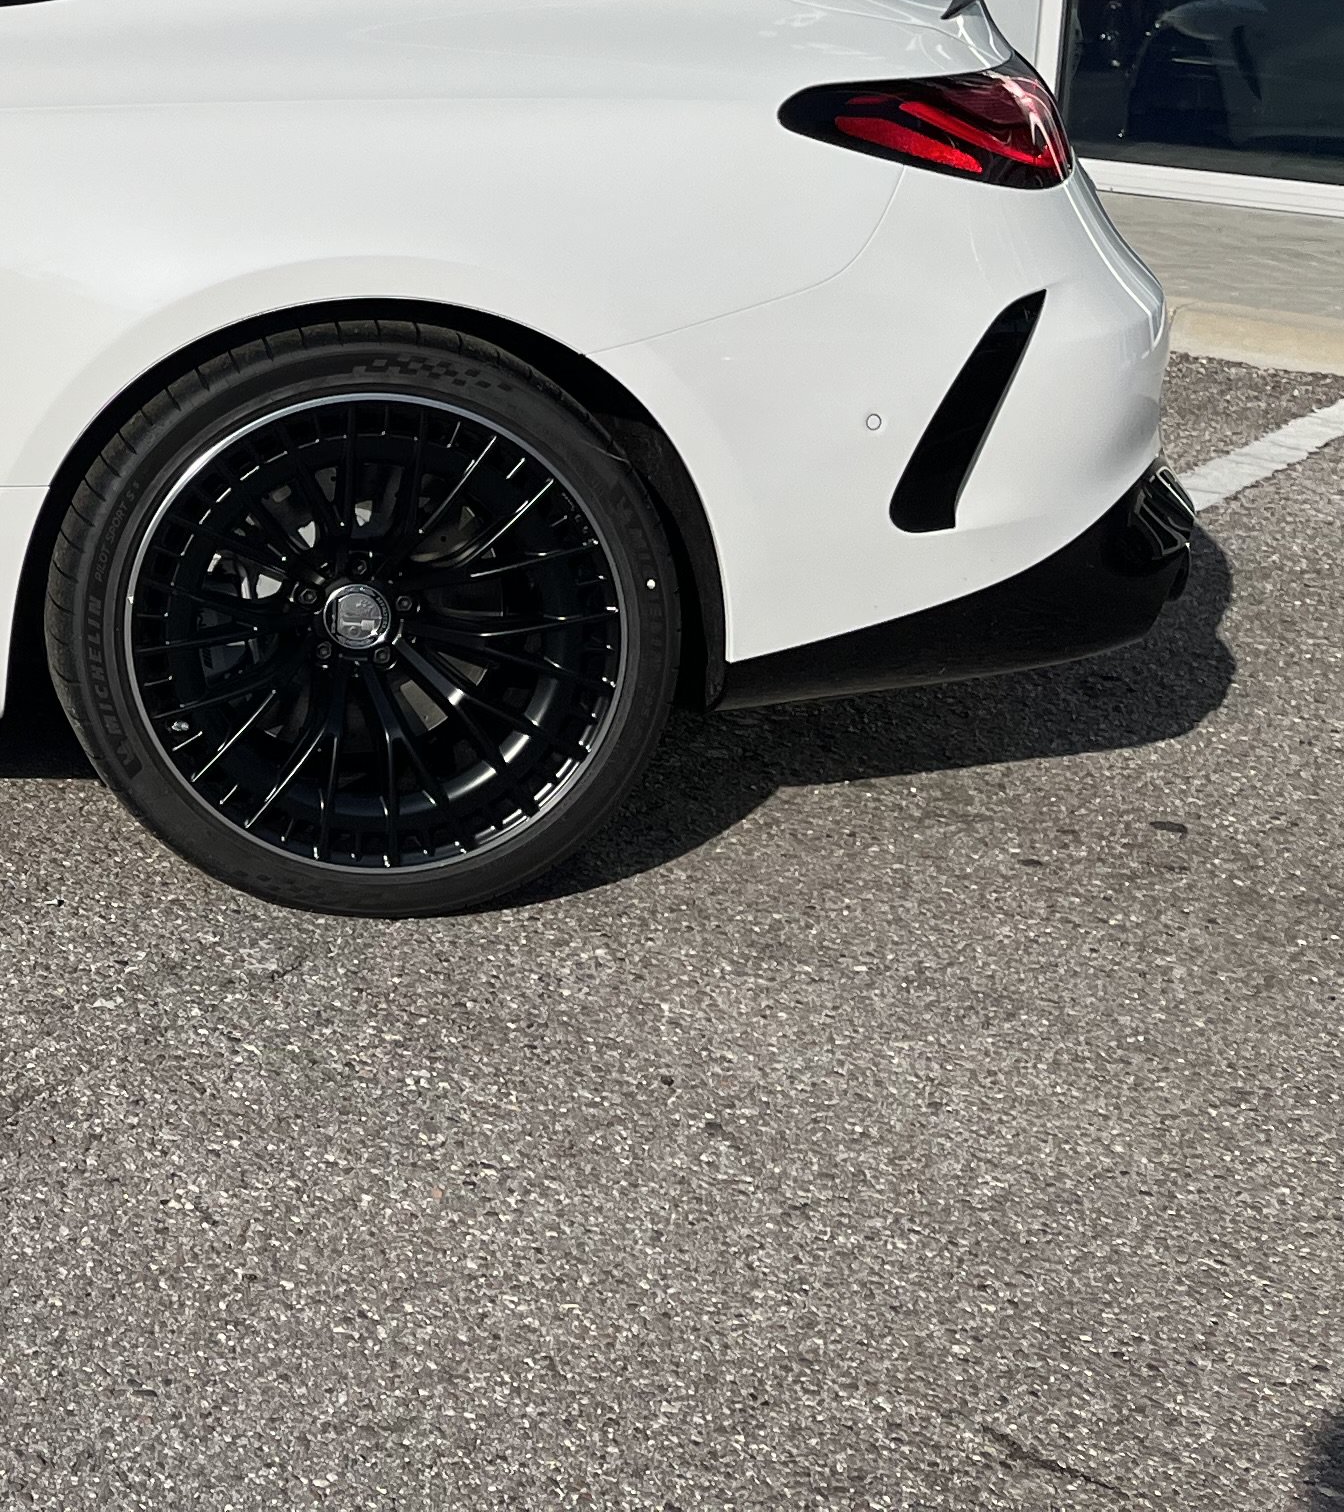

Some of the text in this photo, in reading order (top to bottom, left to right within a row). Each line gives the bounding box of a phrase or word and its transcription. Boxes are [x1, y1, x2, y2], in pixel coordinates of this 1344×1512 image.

[105, 501, 128, 544] SPORT
[93, 543, 111, 584] PILOT
[87, 594, 124, 735] MICHELIN
